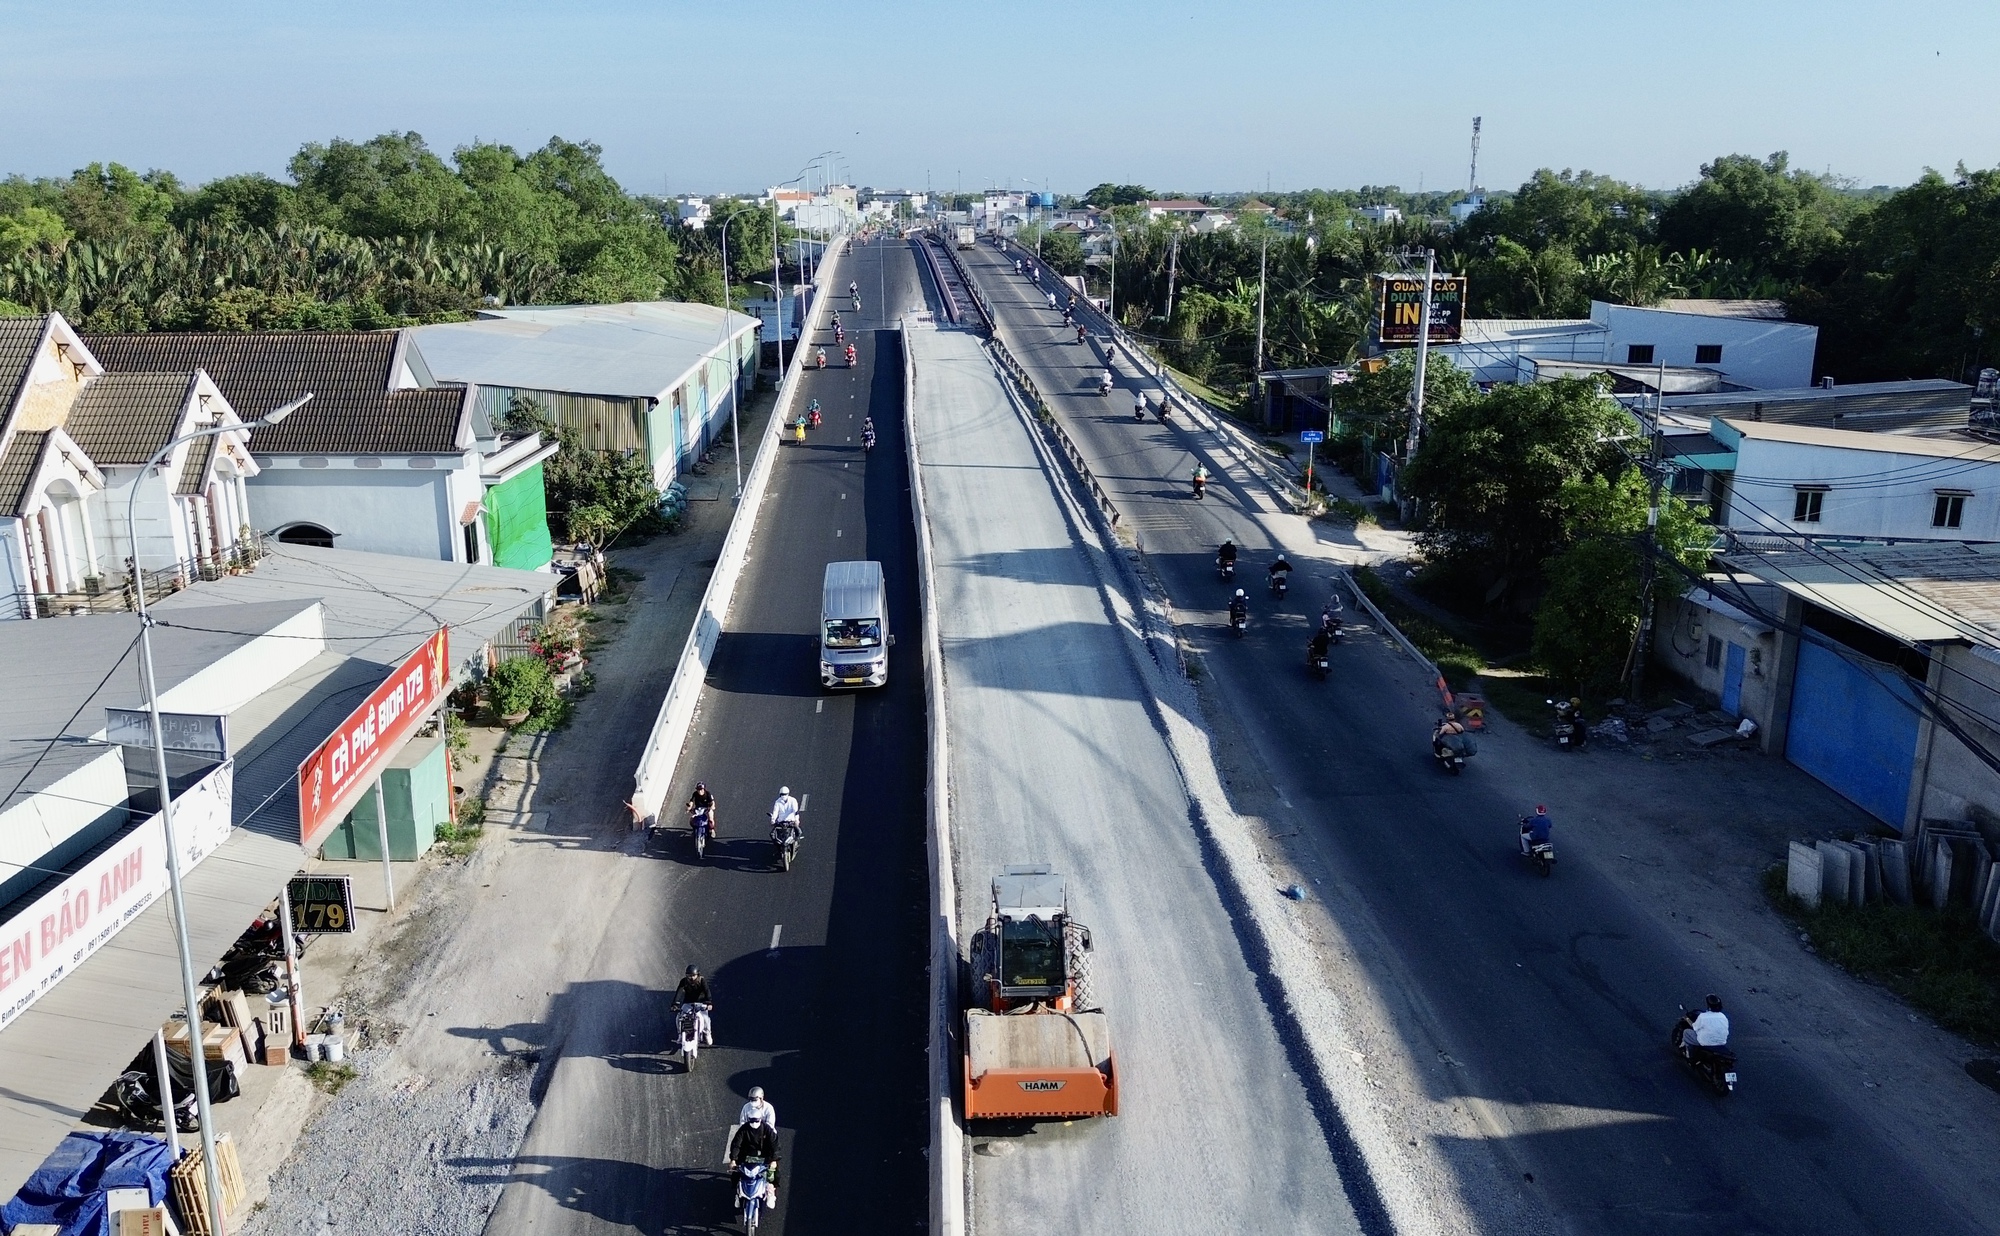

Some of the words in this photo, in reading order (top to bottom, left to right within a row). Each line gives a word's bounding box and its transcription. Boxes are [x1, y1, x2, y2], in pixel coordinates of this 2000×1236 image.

[1391, 293, 1415, 301] DUY
[1418, 293, 1458, 301] TANH
[331, 733, 349, 785] CÀ
[352, 703, 376, 765] PHÊ
[378, 683, 404, 736] BIDA
[406, 664, 423, 706] 179
[291, 882, 341, 900] BIDA
[41, 889, 89, 958] BẢO
[98, 846, 143, 914] ANH
[294, 904, 345, 928] 179
[50, 965, 63, 982] HCM
[1025, 1082, 1058, 1090] HAMM
